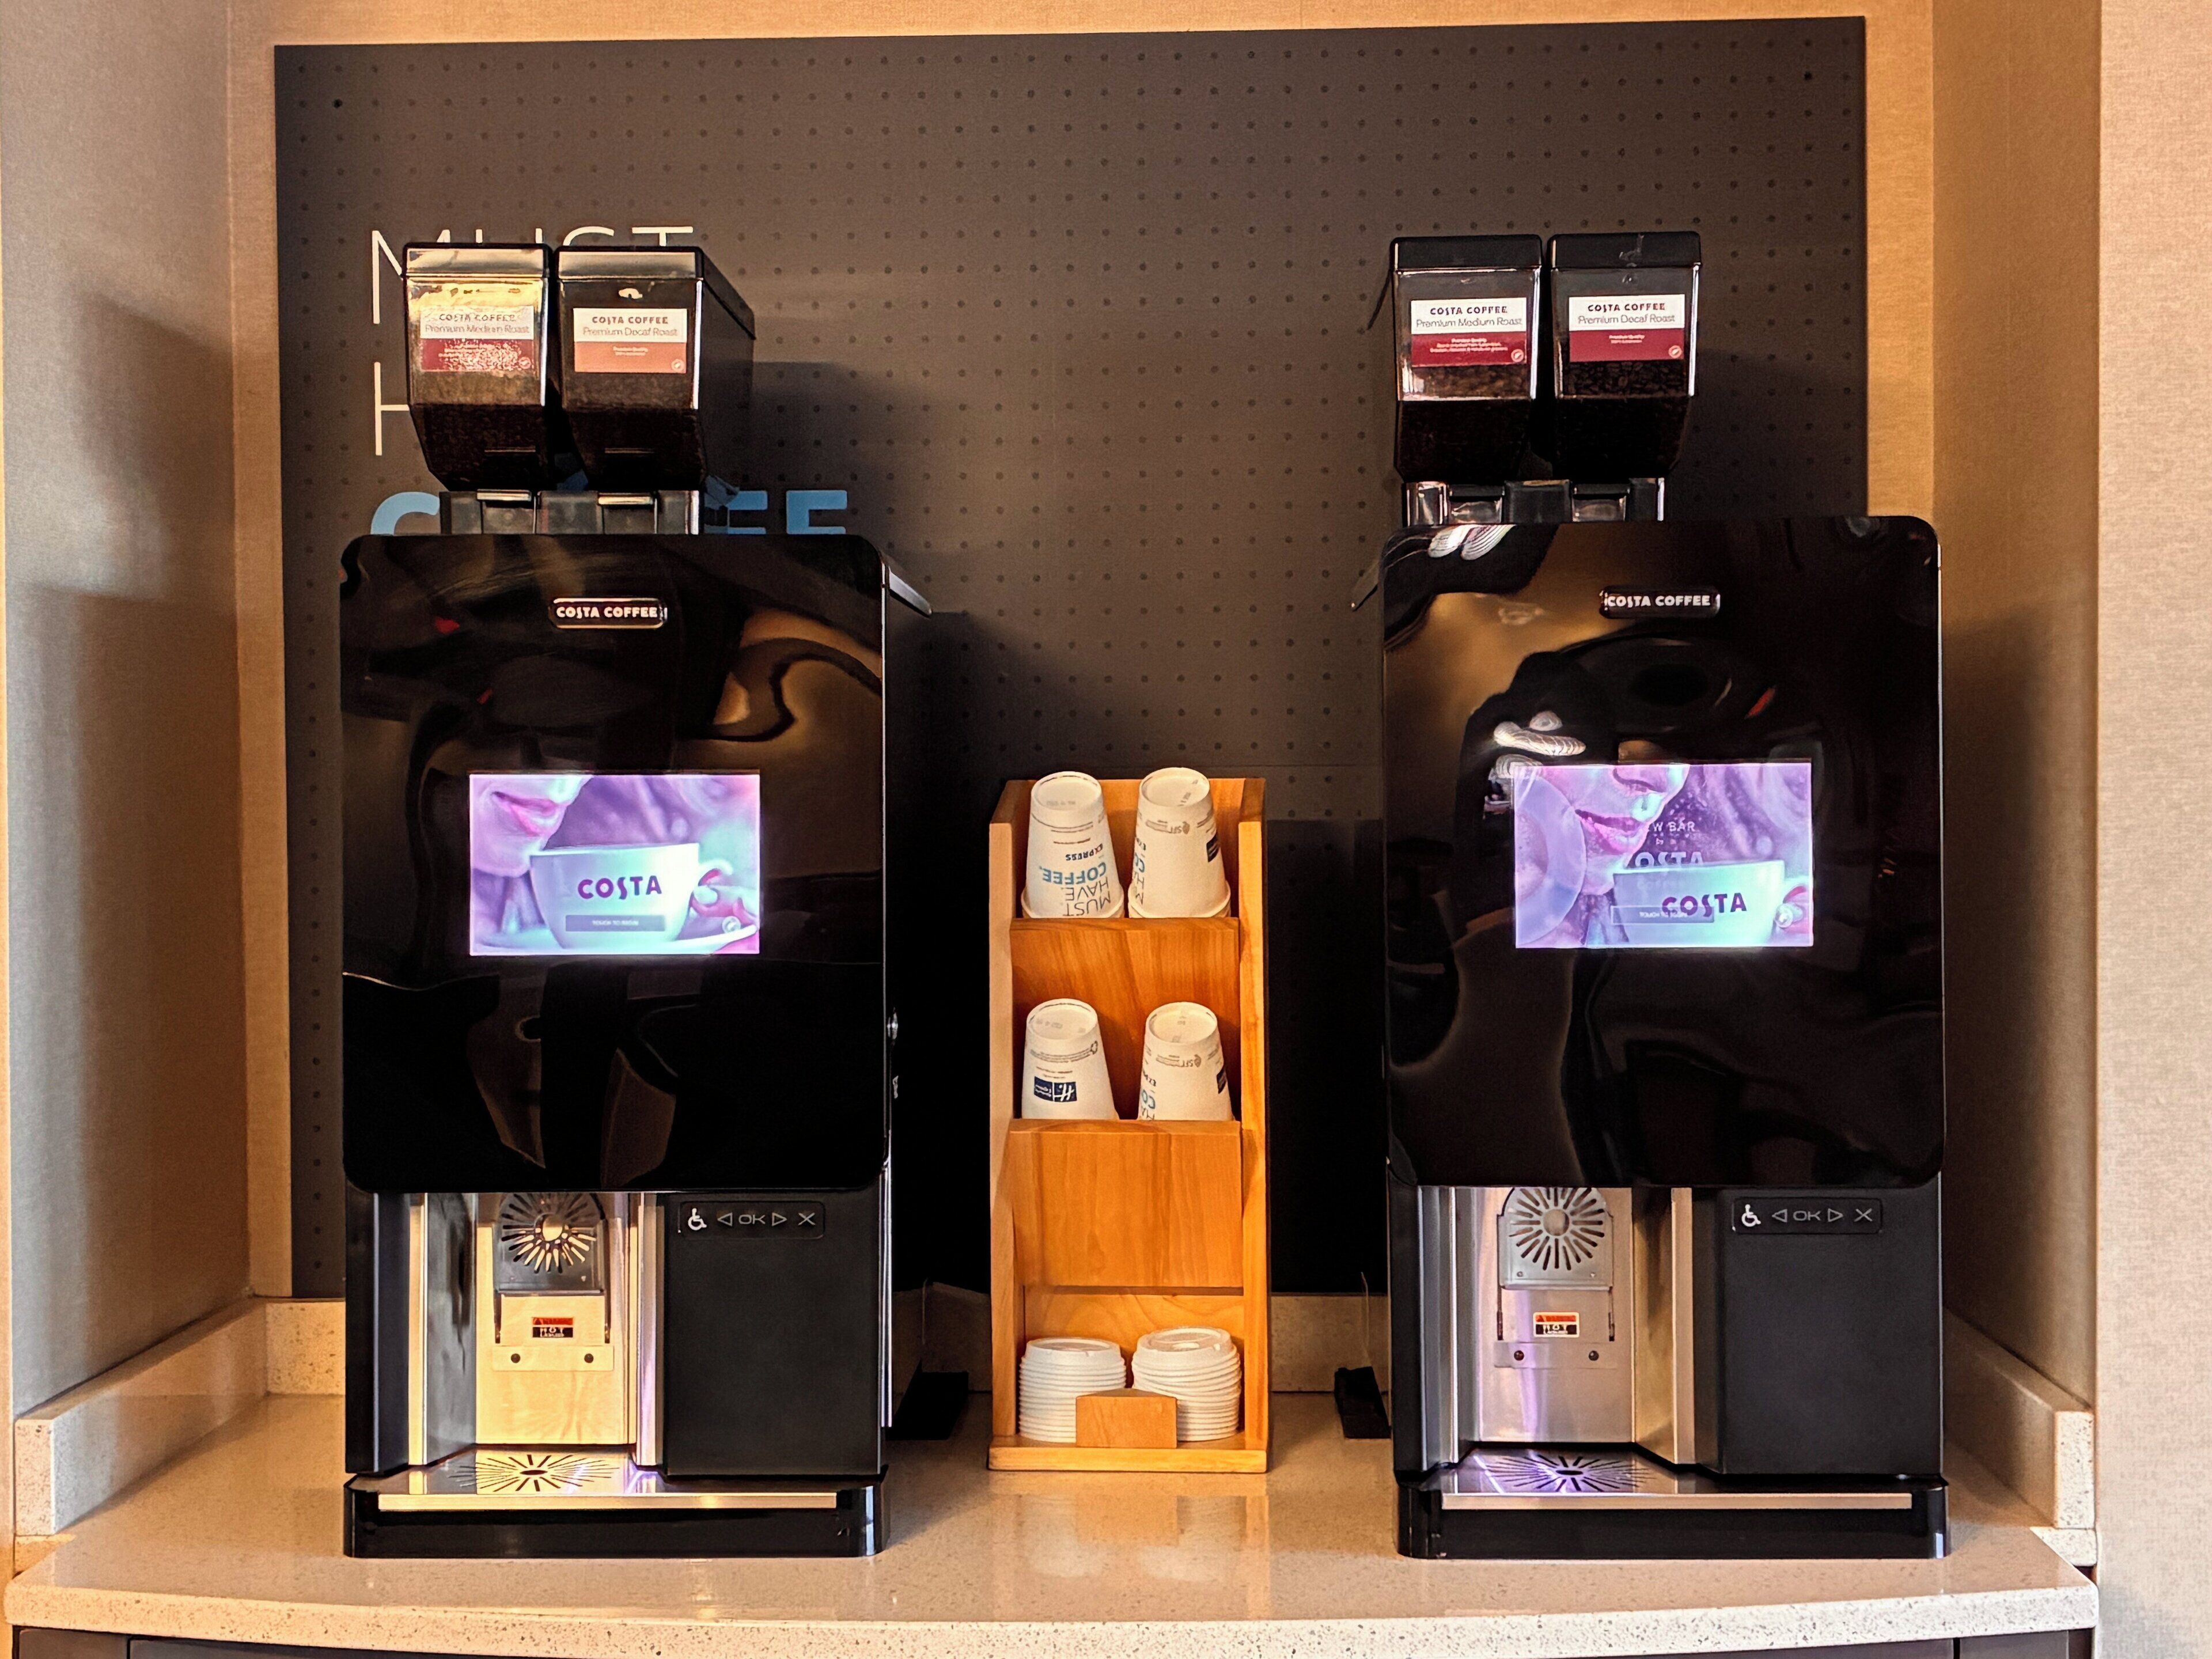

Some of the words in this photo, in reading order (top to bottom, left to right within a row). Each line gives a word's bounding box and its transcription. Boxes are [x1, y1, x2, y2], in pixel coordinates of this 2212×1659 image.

[1430, 306, 1463, 316] COSTA
[1466, 305, 1508, 315] COFFEE
[1587, 304, 1620, 313] COSTA
[1624, 302, 1665, 311] COFFEE
[438, 313, 471, 322] COSTA
[475, 314, 517, 322] COFFEE
[592, 316, 624, 325] COSTA
[628, 316, 669, 324] COFFEE
[1416, 319, 1456, 328] Premium
[1457, 317, 1495, 327] Medium
[1497, 316, 1522, 325] Roast
[1578, 315, 1619, 324] Premium
[1620, 313, 1649, 323] Decaf
[1649, 313, 1675, 323] Roast
[425, 324, 465, 333] Premium
[504, 324, 531, 334] Roast
[583, 327, 623, 336] Premium
[624, 327, 652, 336] Decaf
[653, 328, 678, 336] Roast
[1607, 595, 1652, 608] COSTA
[1654, 595, 1711, 607] COFFEE
[556, 606, 600, 619] COSTA
[603, 606, 658, 618] COFFEE
[1668, 821, 1695, 832] BAR
[1635, 851, 1704, 868] OSTA
[577, 875, 662, 900] COSTA
[1062, 892, 1111, 916] MUST
[1661, 892, 1748, 918] COSTA
[738, 1214, 766, 1225] OK
[1793, 1210, 1821, 1221] OK
